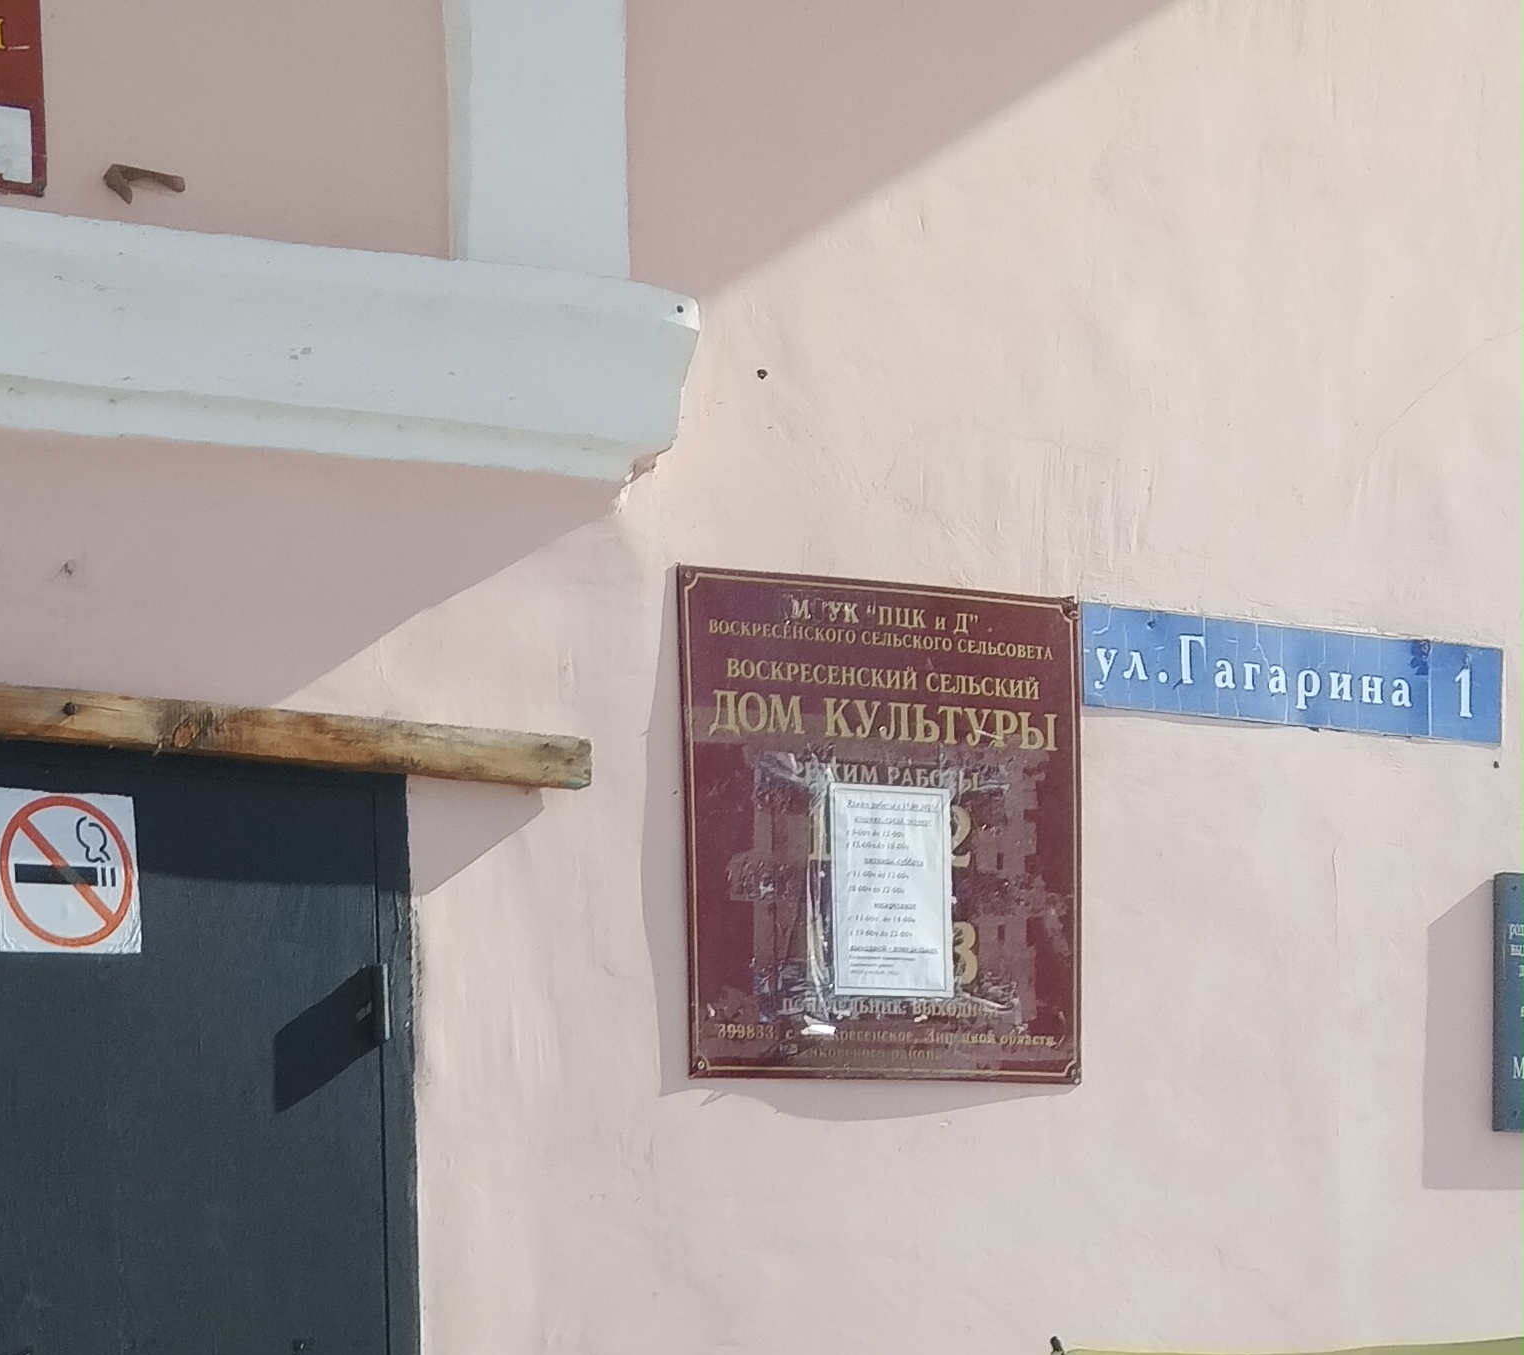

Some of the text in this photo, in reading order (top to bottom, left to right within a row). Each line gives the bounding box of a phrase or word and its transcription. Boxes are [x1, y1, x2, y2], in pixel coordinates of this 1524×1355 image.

[708, 618, 1054, 662] ВОСКРЕСЕНСКОГО СЕЛЬСКОГО СЕЛЬСОВЕТА
[726, 657, 1040, 700] ВОСКРЕСЕНСКИЙ СЕЛЬСКИЙ
[1454, 664, 1474, 718] 1
[707, 688, 1059, 752] ДОМ КУЛЬТУРЫ
